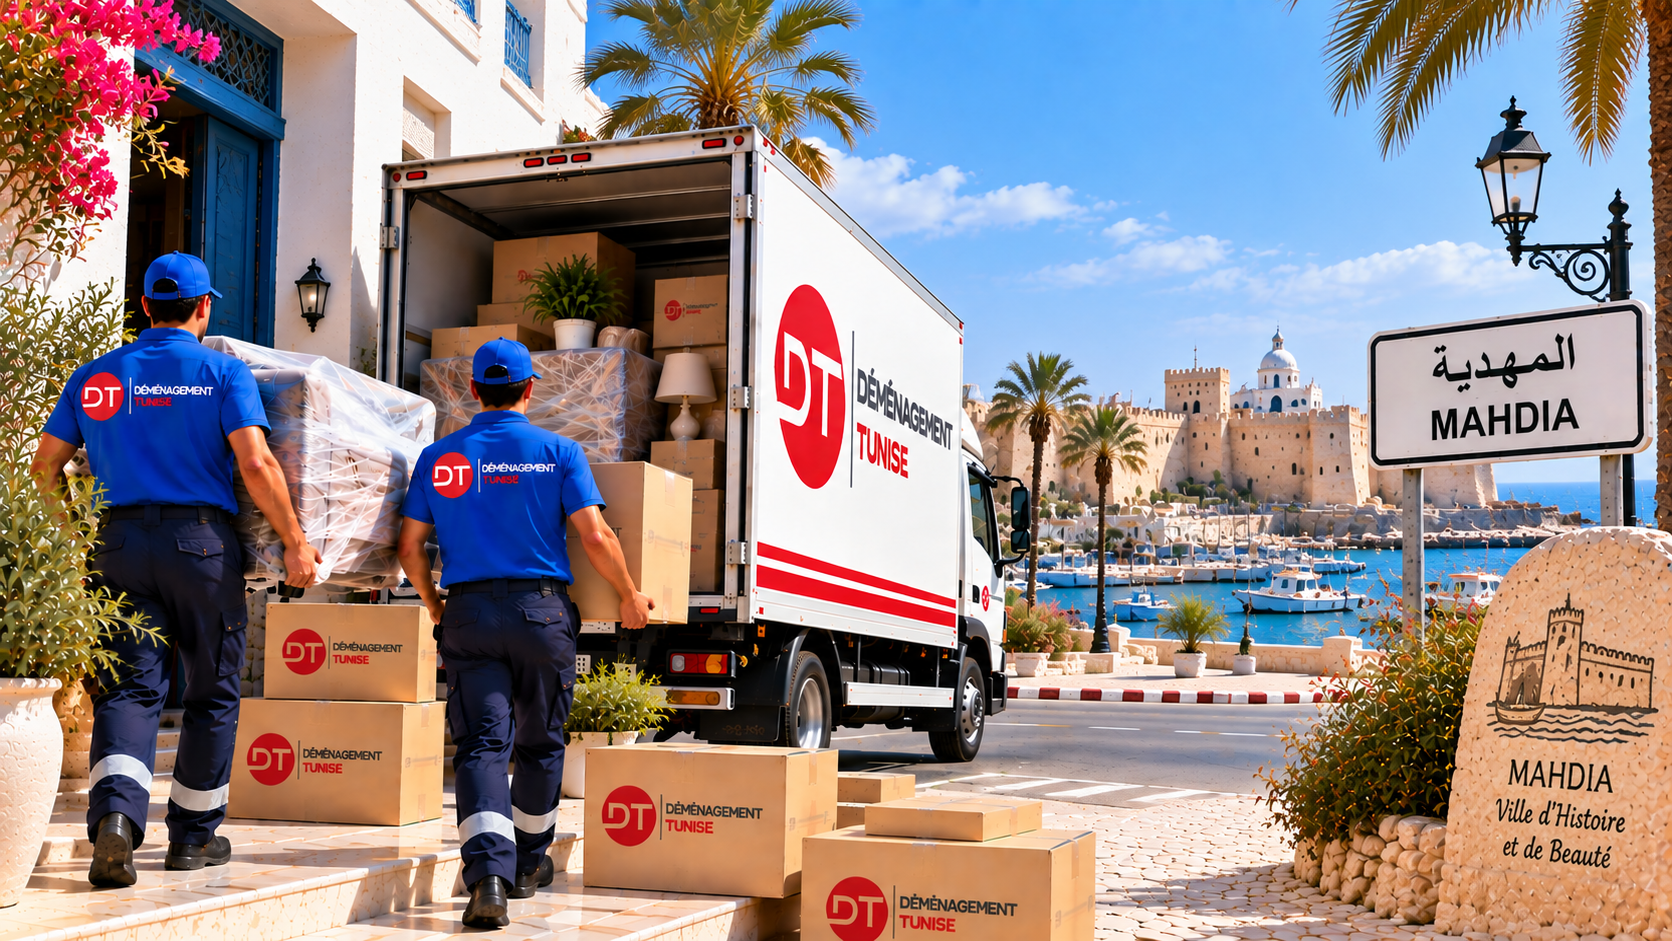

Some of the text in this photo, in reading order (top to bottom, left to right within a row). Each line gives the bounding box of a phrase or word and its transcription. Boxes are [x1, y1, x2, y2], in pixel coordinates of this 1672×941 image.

[1432, 333, 1576, 393] المهدية
[134, 383, 213, 396] DÉMÉNAGEMENT
[777, 331, 843, 438] DT
[82, 386, 121, 408] DT
[134, 397, 172, 407] TUNISE
[857, 367, 953, 450] DÉMÉNAGEMENT
[1431, 398, 1580, 441] MAHDIA
[856, 421, 909, 479] TUNISE
[433, 465, 471, 487] DT
[482, 462, 556, 473] DÉMÉNAGEMENT
[283, 641, 324, 664] DT
[332, 641, 403, 653] DÉMÉNAGEMENT
[332, 654, 370, 665] TUNISE
[250, 747, 292, 771] DT
[303, 747, 383, 761] DÉMÉNAGEMENT
[302, 762, 343, 774] TUNISE
[1508, 759, 1613, 793] MAHDIA
[602, 802, 653, 831] DT
[665, 801, 763, 819] DÉMÉNAGEMENT
[1496, 798, 1625, 833] Ville d'Histoire
[665, 819, 714, 834] TUNISE
[1503, 835, 1612, 868] et de Beauté
[827, 894, 884, 928] DT
[899, 893, 1018, 917] DÉMÉNAGEMENT
[899, 914, 956, 933] TUNISE
